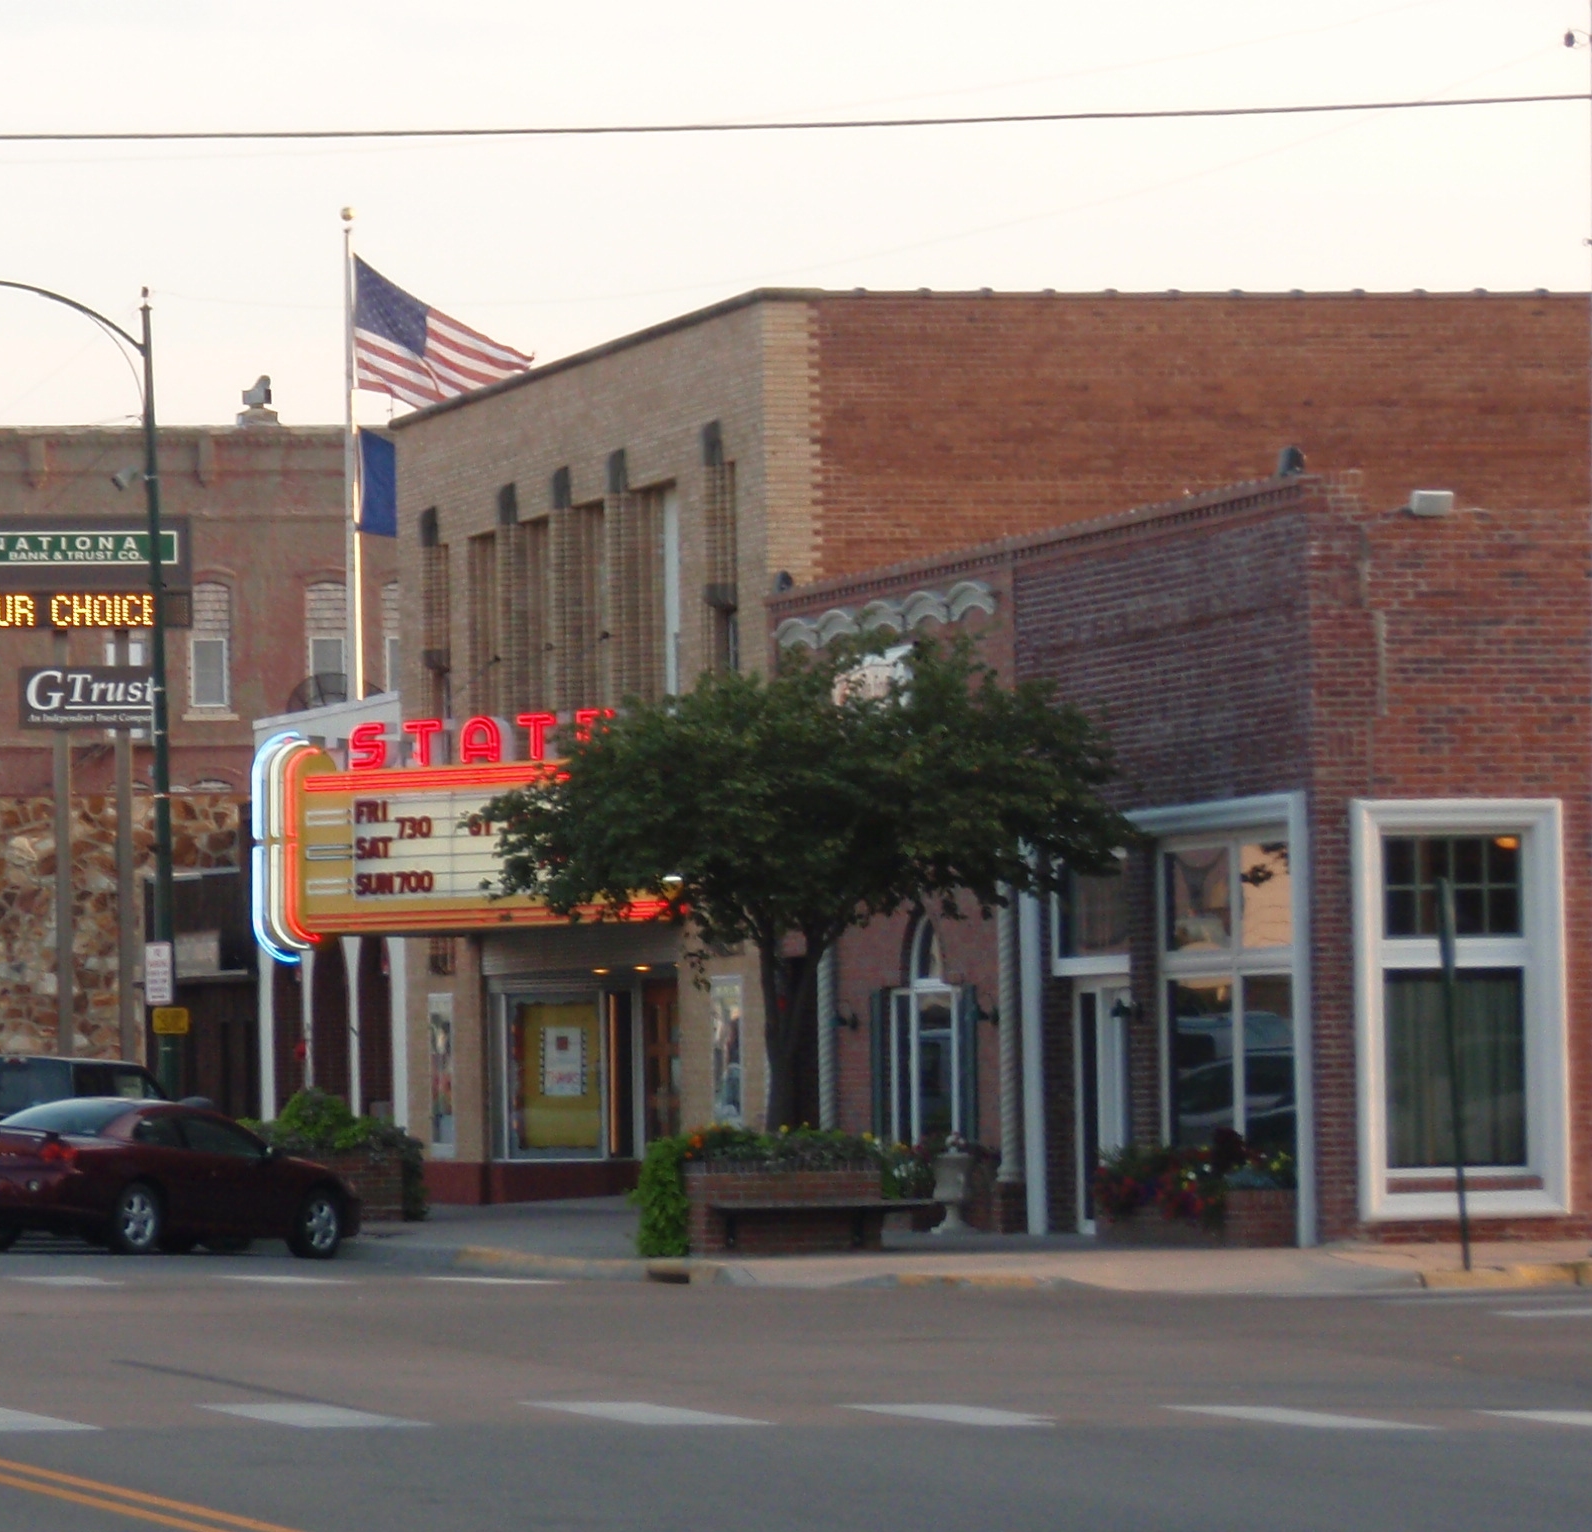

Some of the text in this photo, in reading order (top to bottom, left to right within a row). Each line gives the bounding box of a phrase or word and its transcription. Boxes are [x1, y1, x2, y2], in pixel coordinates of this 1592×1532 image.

[9, 551, 144, 561] BANK & TRUST CO.
[50, 594, 154, 628] CHOICE
[43, 713, 94, 724] Independent
[96, 713, 117, 722] Trust
[355, 800, 388, 824] FRI
[395, 815, 432, 839] 730
[355, 836, 392, 859] SAT
